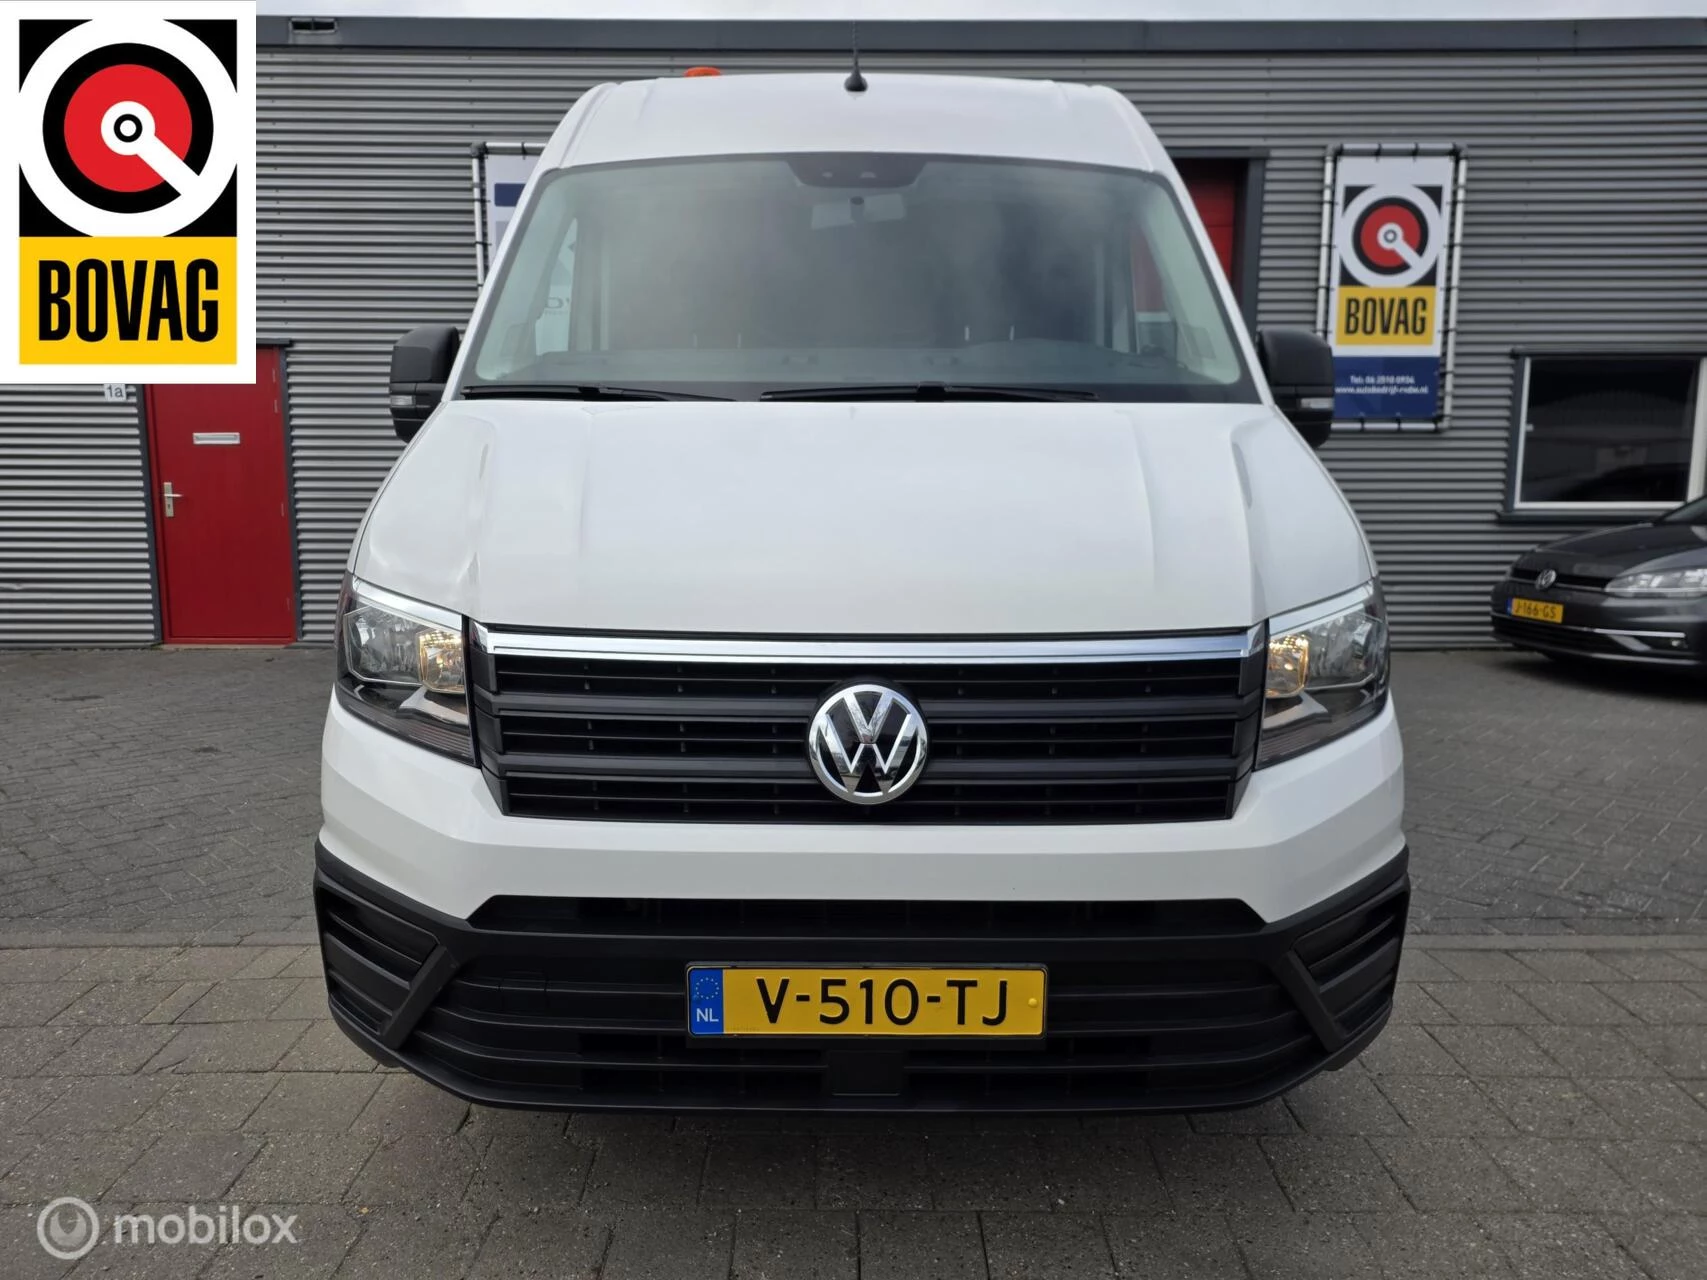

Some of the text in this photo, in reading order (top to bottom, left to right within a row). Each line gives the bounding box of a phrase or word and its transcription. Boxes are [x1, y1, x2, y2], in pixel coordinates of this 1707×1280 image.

[1344, 297, 1427, 335] BOVAG
[107, 383, 124, 398] 1a
[696, 977, 1008, 1026] NL V-510-TJ
